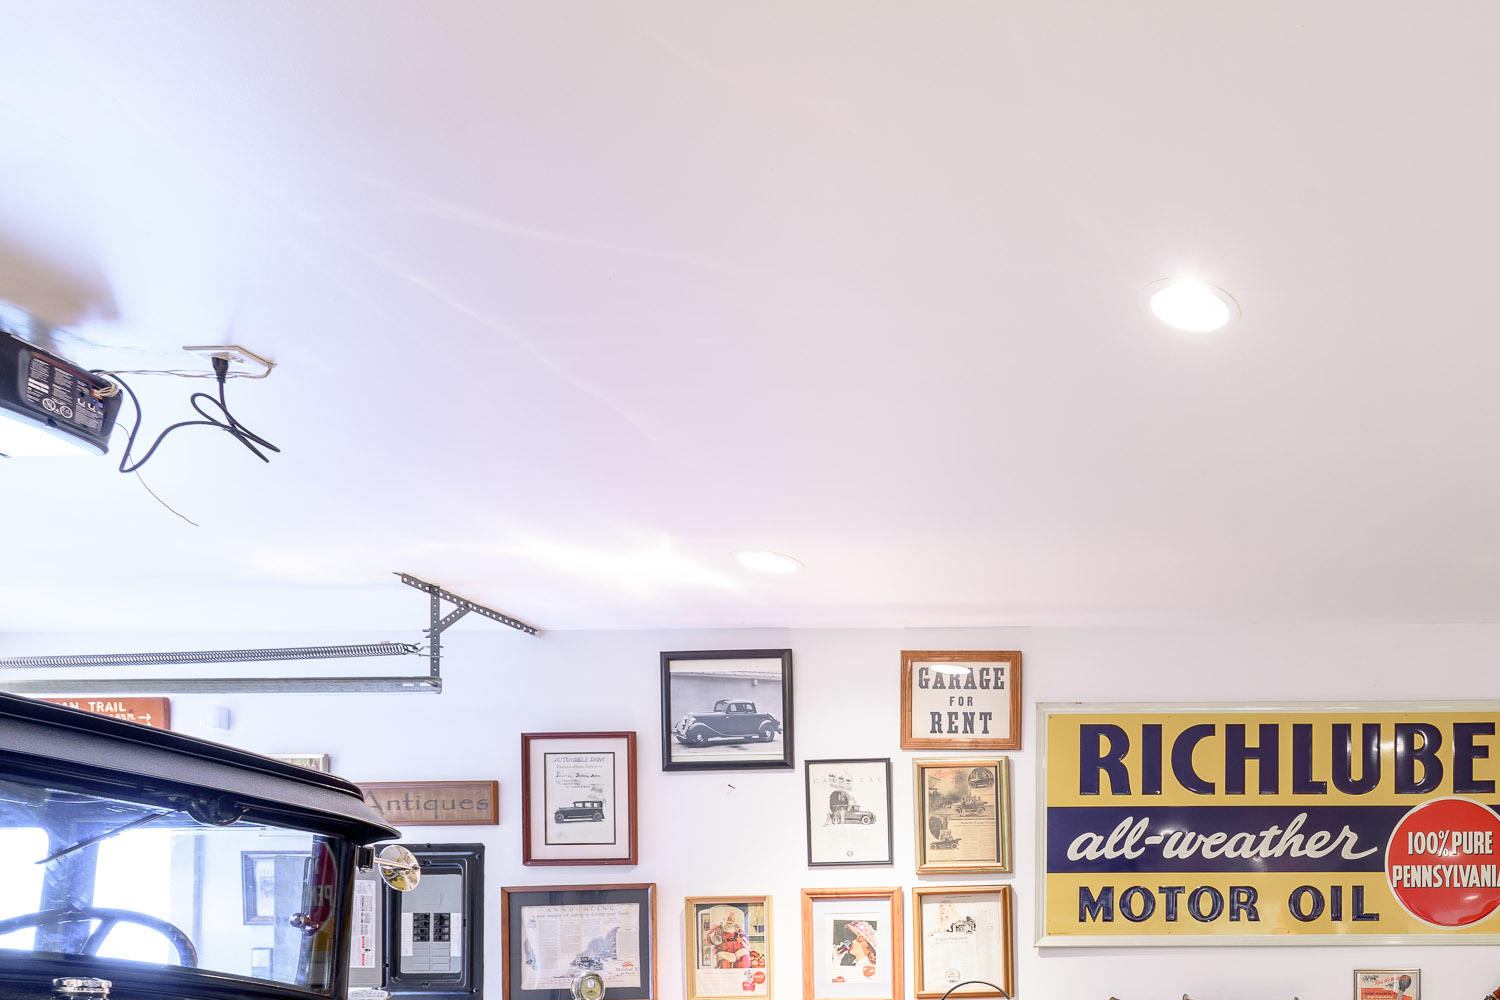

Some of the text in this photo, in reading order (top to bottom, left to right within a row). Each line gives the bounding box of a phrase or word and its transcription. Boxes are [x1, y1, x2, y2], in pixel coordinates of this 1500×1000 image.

[918, 667, 1005, 690] GARAGE
[88, 702, 127, 712] TRAIL
[949, 696, 974, 707] FOR
[929, 711, 994, 735] RENT
[1078, 722, 1496, 796] RICHLUBE
[364, 789, 490, 813] Antiques
[1067, 812, 1378, 861] all-weather
[1406, 829, 1494, 856] 100% PURE
[1078, 884, 1380, 923] MOTOR OIL
